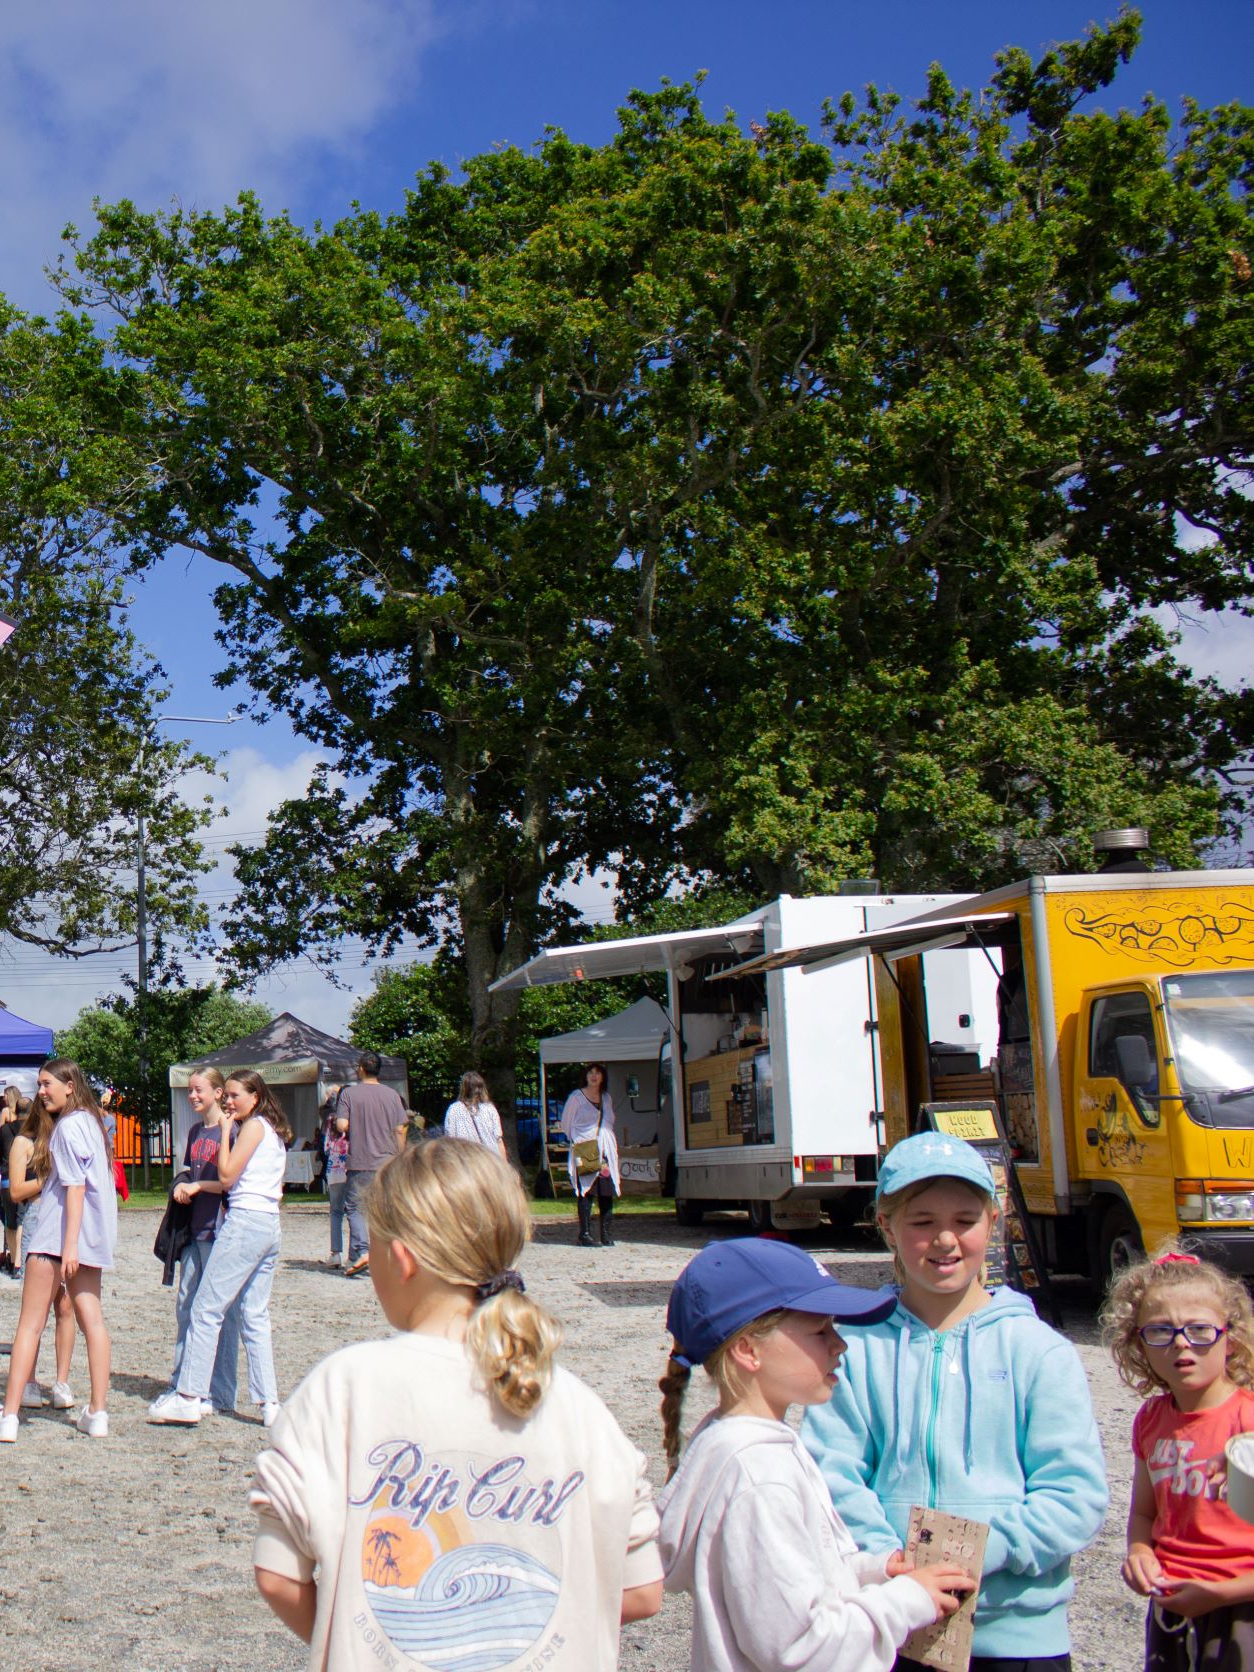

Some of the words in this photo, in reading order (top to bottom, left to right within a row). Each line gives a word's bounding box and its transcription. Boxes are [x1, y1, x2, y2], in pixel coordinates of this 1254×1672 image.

[948, 1114, 977, 1125] WOOD
[1148, 1438, 1195, 1466] JUST
[348, 1439, 460, 1528] Rip
[465, 1456, 585, 1528] Curl
[354, 1612, 399, 1671] BORN
